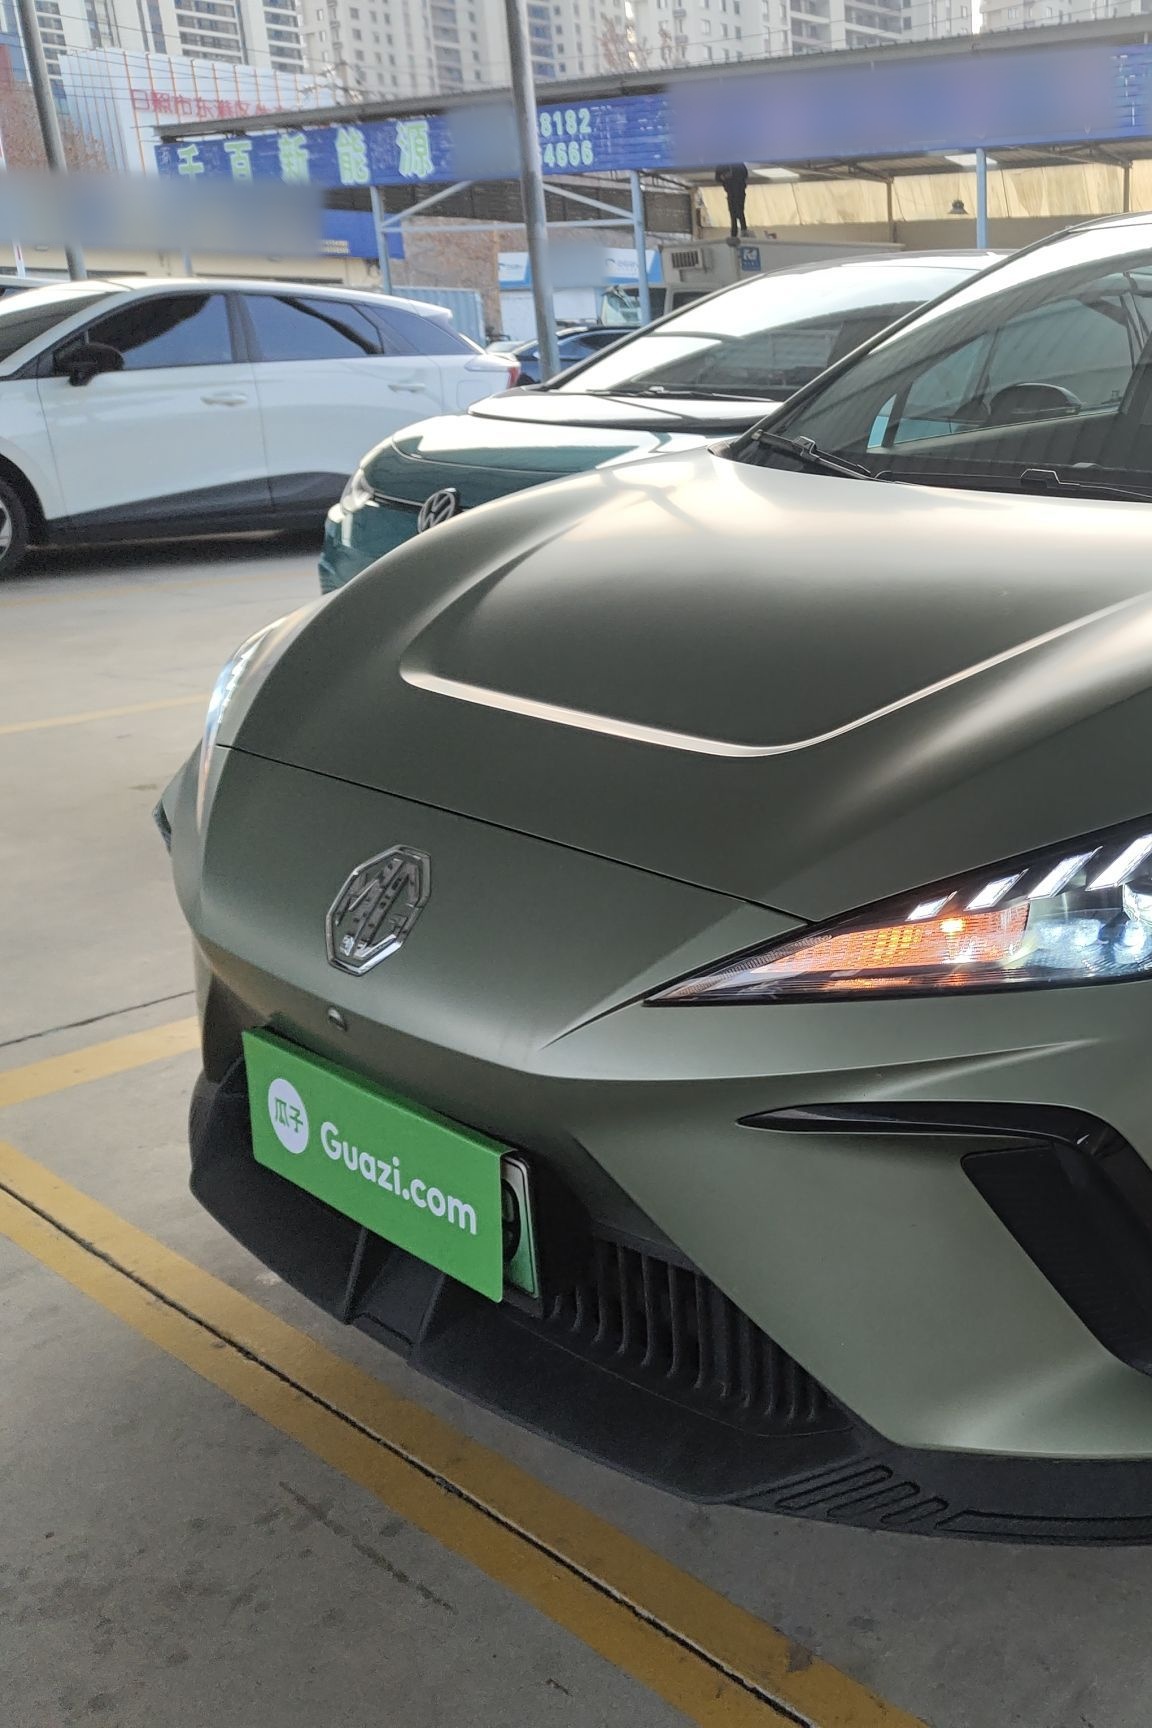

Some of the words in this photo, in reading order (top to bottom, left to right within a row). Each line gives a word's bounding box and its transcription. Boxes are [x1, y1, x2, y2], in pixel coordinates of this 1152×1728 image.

[539, 107, 592, 137] 8182
[543, 140, 594, 167] 4666
[274, 1096, 304, 1134] 瓜子
[320, 1121, 477, 1235] Guazi.com
